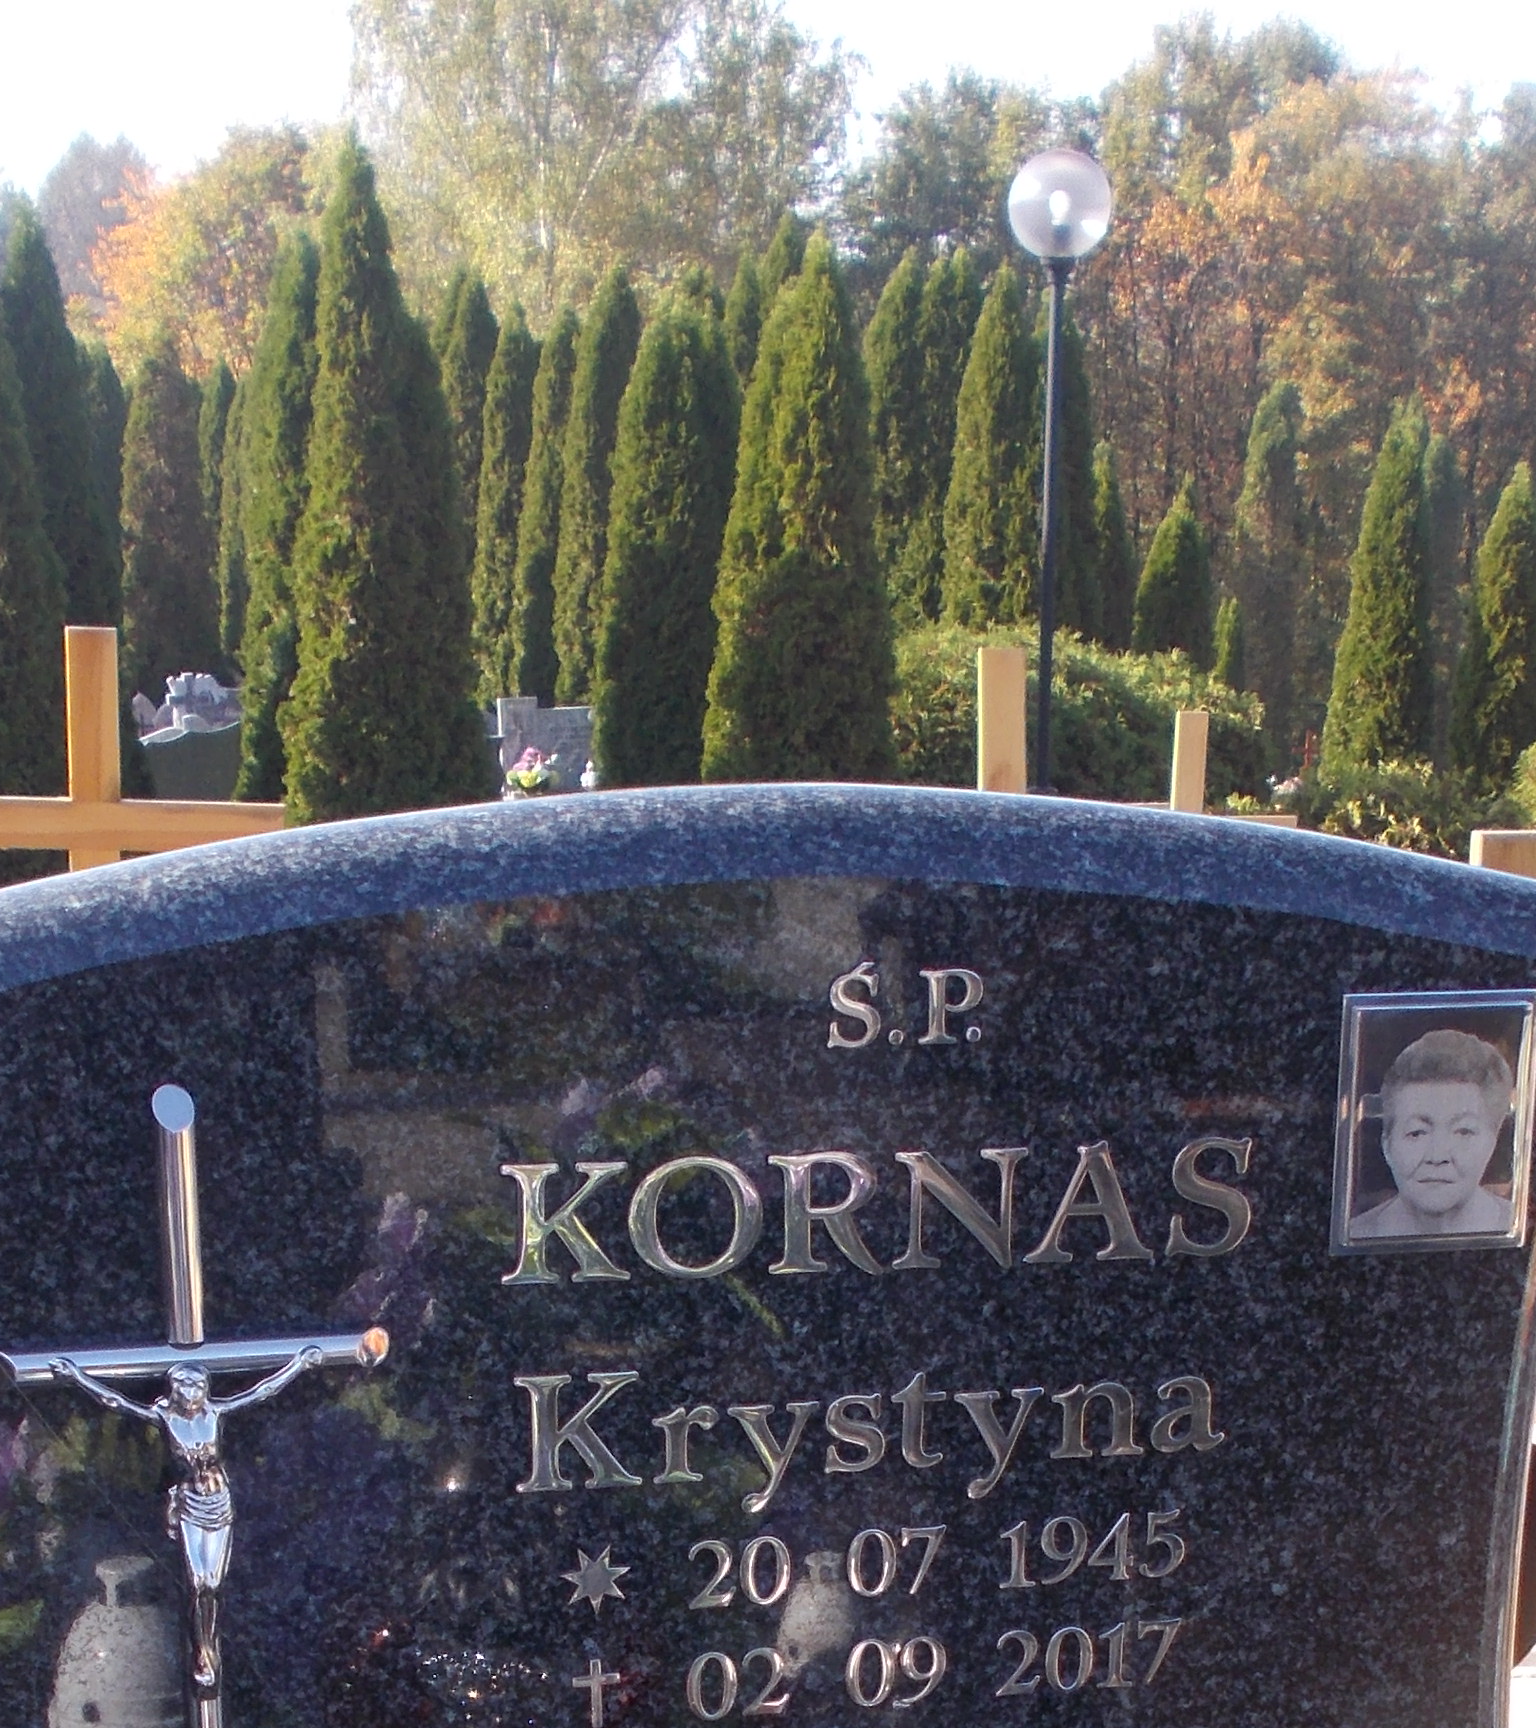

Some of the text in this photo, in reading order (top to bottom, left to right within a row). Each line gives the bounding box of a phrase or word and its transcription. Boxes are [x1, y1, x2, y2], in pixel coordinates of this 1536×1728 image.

[500, 1137, 1255, 1286] KORNAS
[513, 1371, 1226, 1514] Krystyna
[687, 1509, 1186, 1610] 20 07 1945
[686, 1619, 1183, 1721] 02 09 2017
